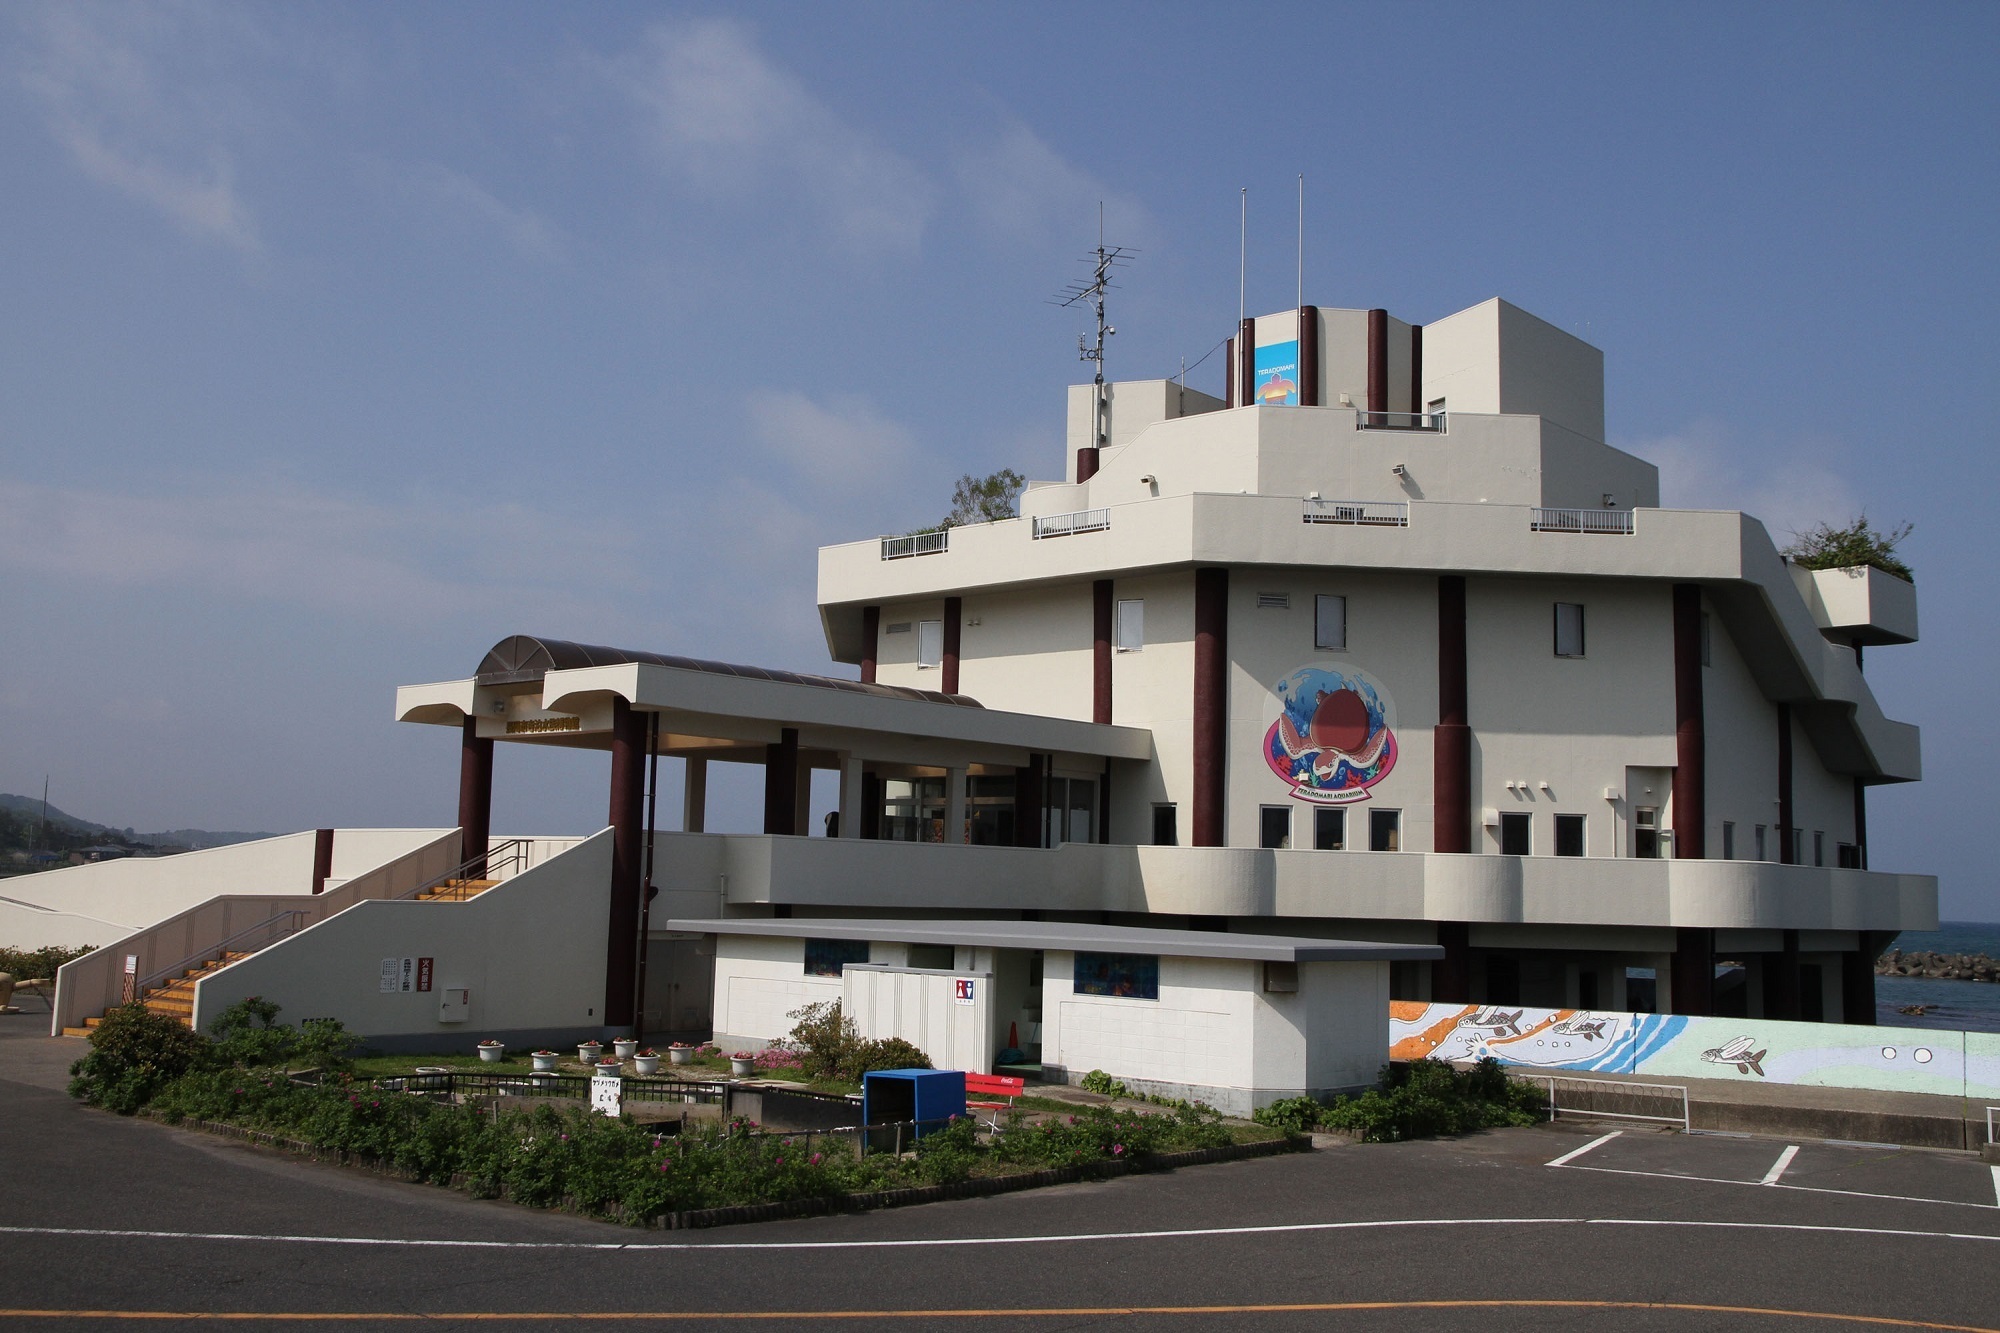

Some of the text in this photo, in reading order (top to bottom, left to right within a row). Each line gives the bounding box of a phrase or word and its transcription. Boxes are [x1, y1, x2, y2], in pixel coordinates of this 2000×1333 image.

[1258, 364, 1294, 376] TERADOMARI
[1297, 788, 1364, 799] TERADOMARI AQUARIUM
